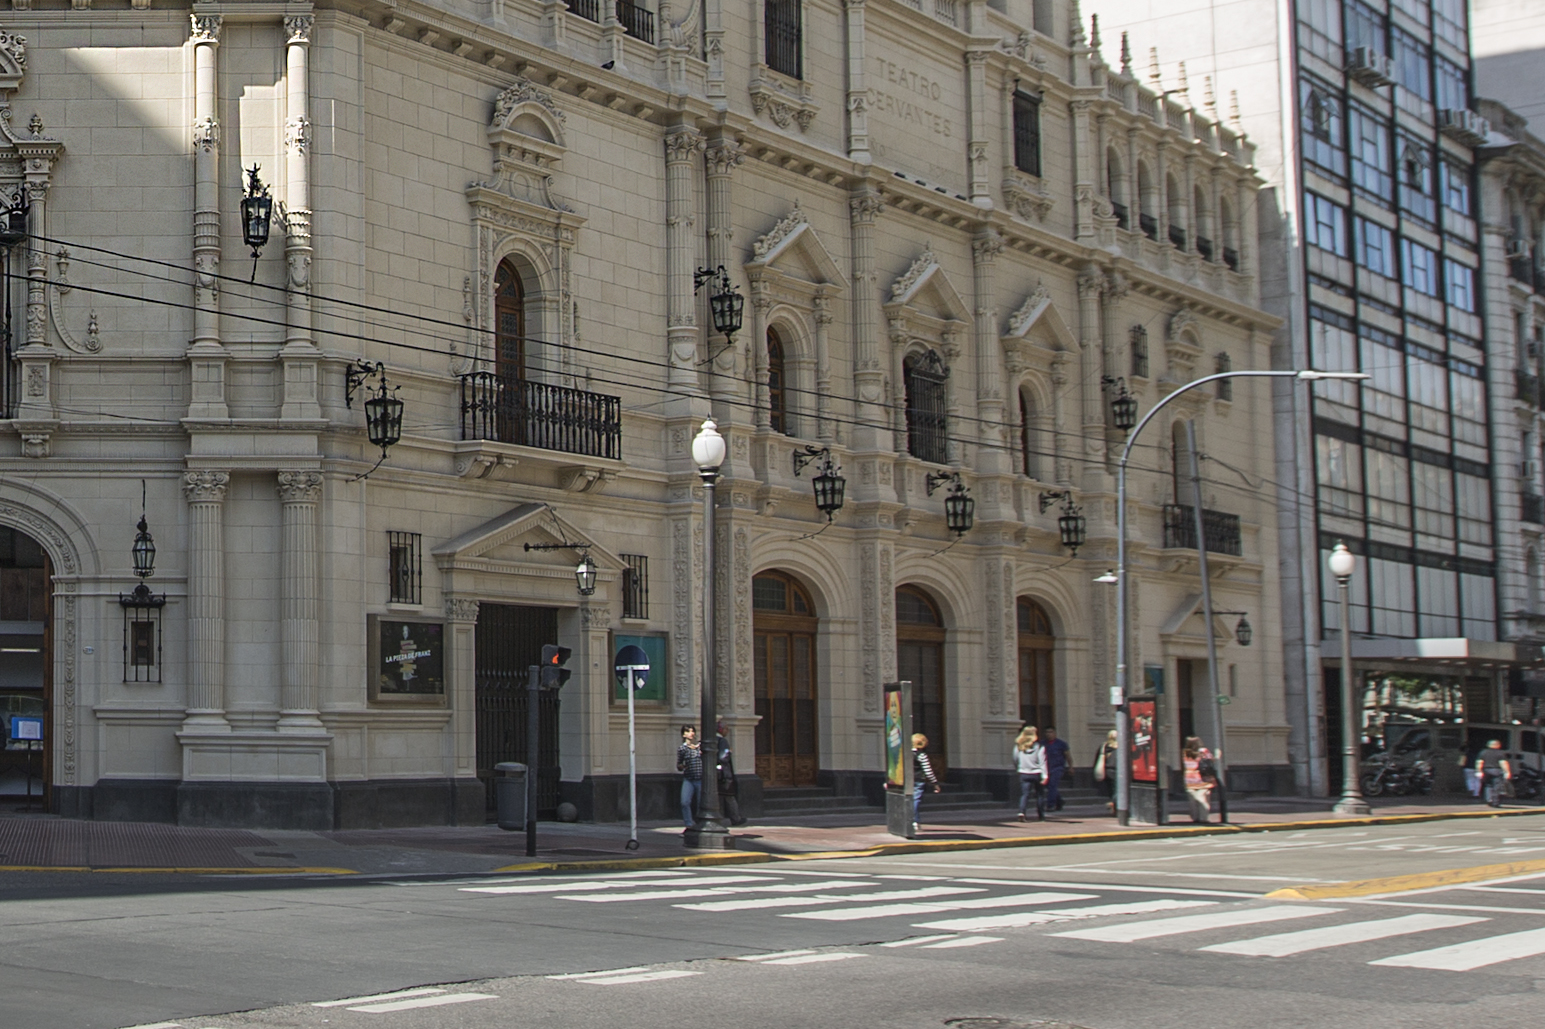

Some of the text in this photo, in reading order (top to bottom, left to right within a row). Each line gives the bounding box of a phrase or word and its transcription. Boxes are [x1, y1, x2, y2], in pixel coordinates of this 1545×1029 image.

[876, 56, 942, 101] TEATRO
[866, 87, 952, 138] CERVANTES
[385, 649, 432, 663] LA PIEZA DE FRANZ
